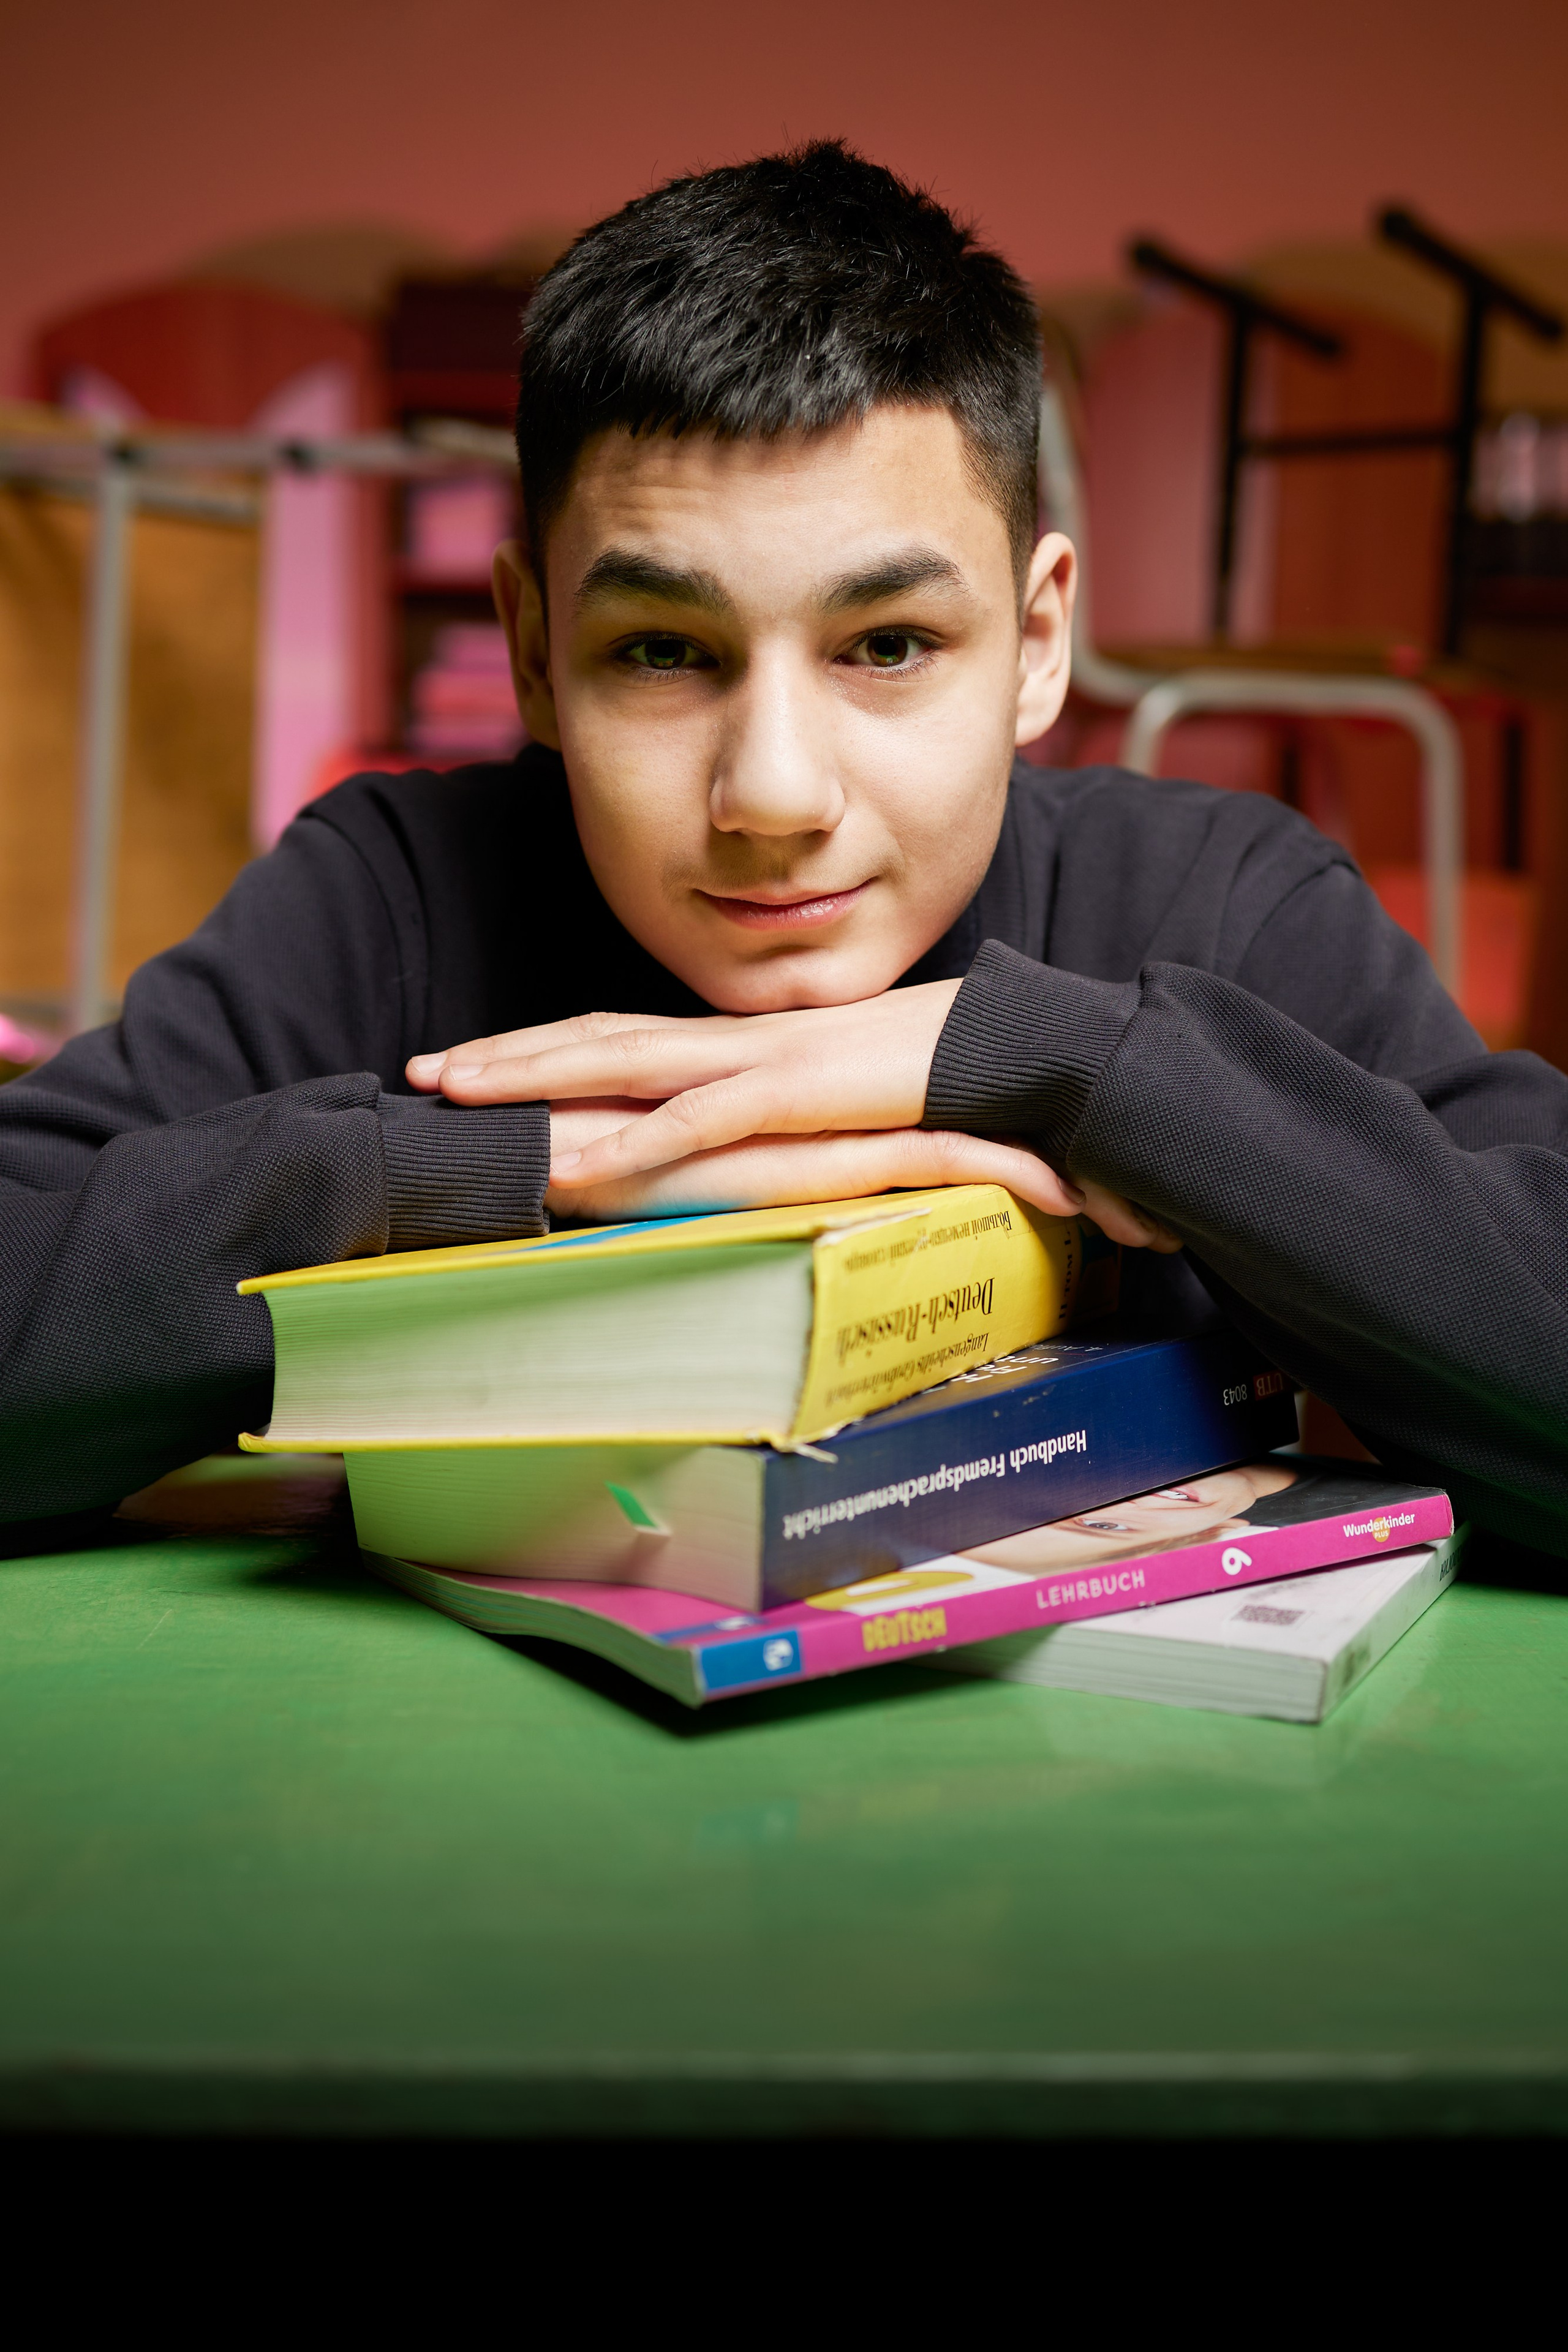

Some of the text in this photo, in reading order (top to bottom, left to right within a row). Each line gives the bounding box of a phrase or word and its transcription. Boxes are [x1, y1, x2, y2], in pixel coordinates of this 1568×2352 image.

[971, 1210, 1012, 1241] Большой
[837, 1278, 995, 1368] Deutsch-Russisch
[916, 1332, 989, 1374] Langenscheidts
[1223, 1372, 1284, 1406] UTB 8043
[782, 1429, 1088, 1542] Handbuch Fremdsprachenunterricht
[1342, 1512, 1415, 1538] Wunderkinder
[1374, 1529, 1390, 1539] PLUS
[1035, 1569, 1146, 1610] LEHRBUCH
[861, 1605, 948, 1653] DEUTSCH
